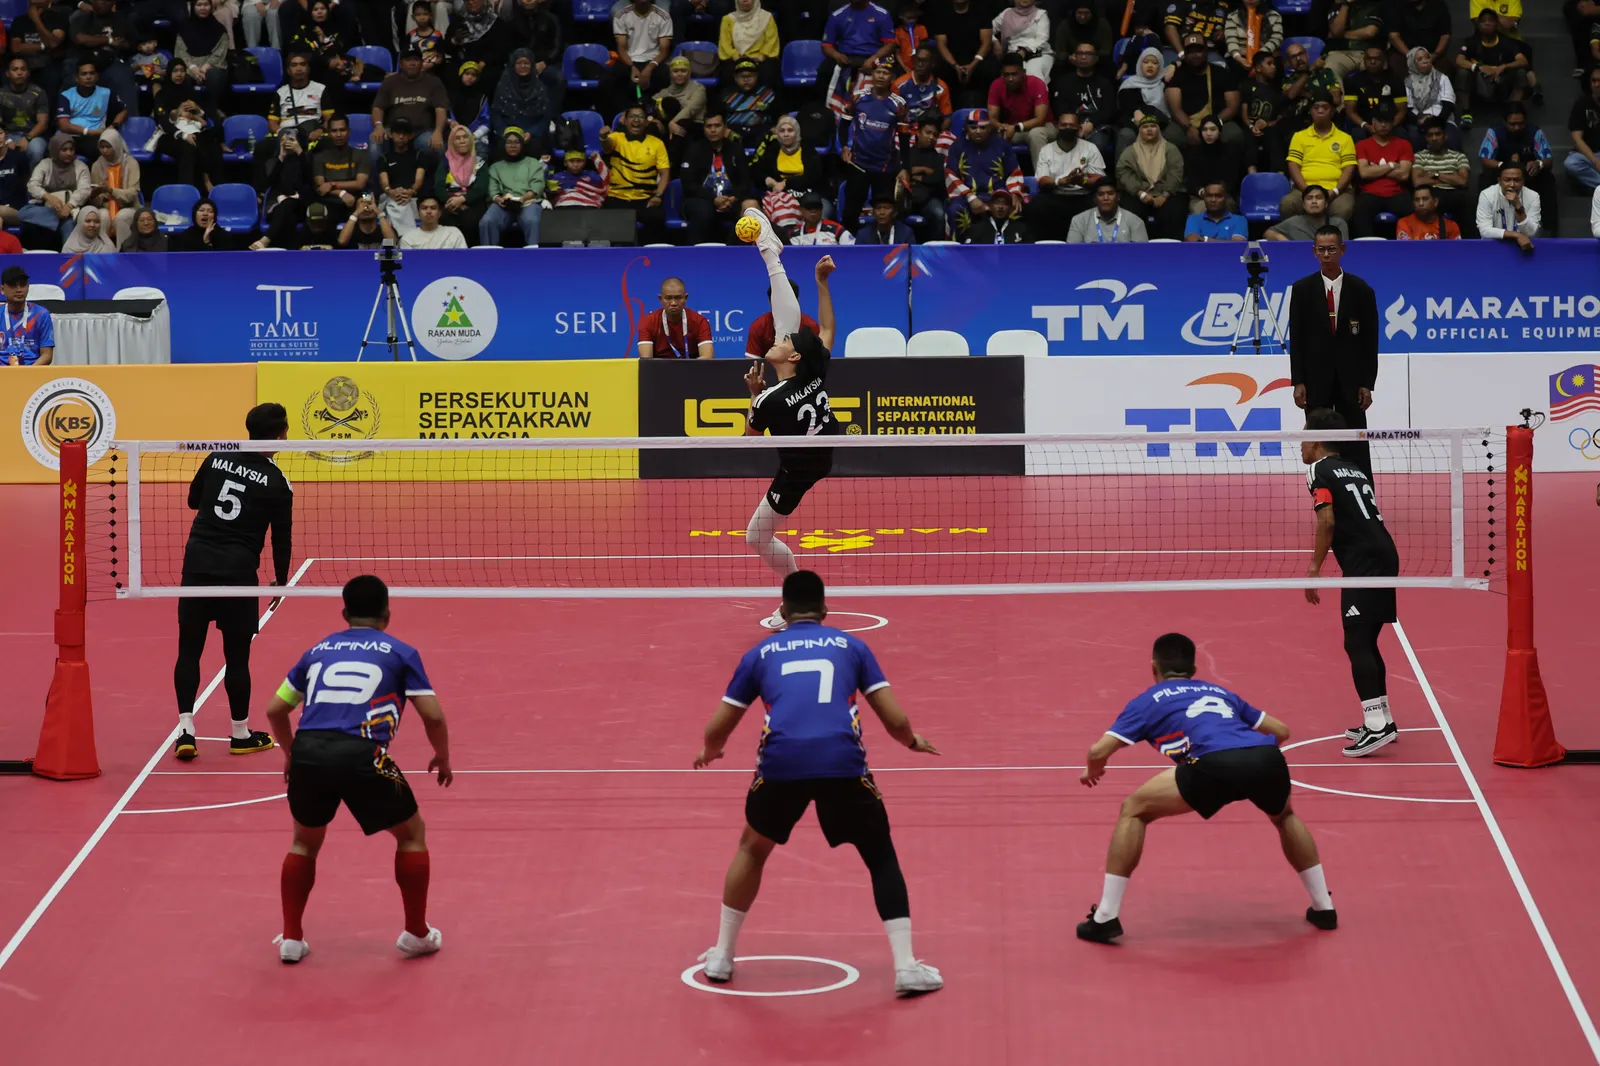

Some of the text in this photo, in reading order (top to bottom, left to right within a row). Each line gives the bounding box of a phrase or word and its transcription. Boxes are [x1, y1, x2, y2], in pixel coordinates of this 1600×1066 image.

[249, 321, 318, 338] TAMU
[555, 311, 617, 334] SERI
[1032, 304, 1144, 341] TM
[428, 329, 481, 337] RAKAN MUDA
[1426, 328, 1509, 340] OFFICIAL
[419, 391, 588, 409] PERSEKUTUAN
[785, 377, 823, 407] MALAYSIA
[877, 395, 976, 407] INTERNATIONAL
[418, 411, 591, 429] SEPAKTAKRAW
[797, 390, 831, 436] 23
[877, 410, 976, 422] SEPAKTAKRAW
[55, 416, 91, 432] KBS
[877, 426, 976, 436] FEDERATION
[1125, 407, 1282, 457] TM
[1366, 430, 1420, 440] MARATHON
[187, 442, 240, 450] MARATHON
[211, 458, 268, 486] MALAYSIA
[213, 478, 247, 521] 5
[1515, 484, 1527, 571] MARATHON
[63, 498, 76, 585] MARATHON
[311, 640, 392, 654] PILIPINAS
[760, 636, 848, 660] PILIPINAS
[306, 661, 383, 707] 19
[781, 658, 835, 704] 7
